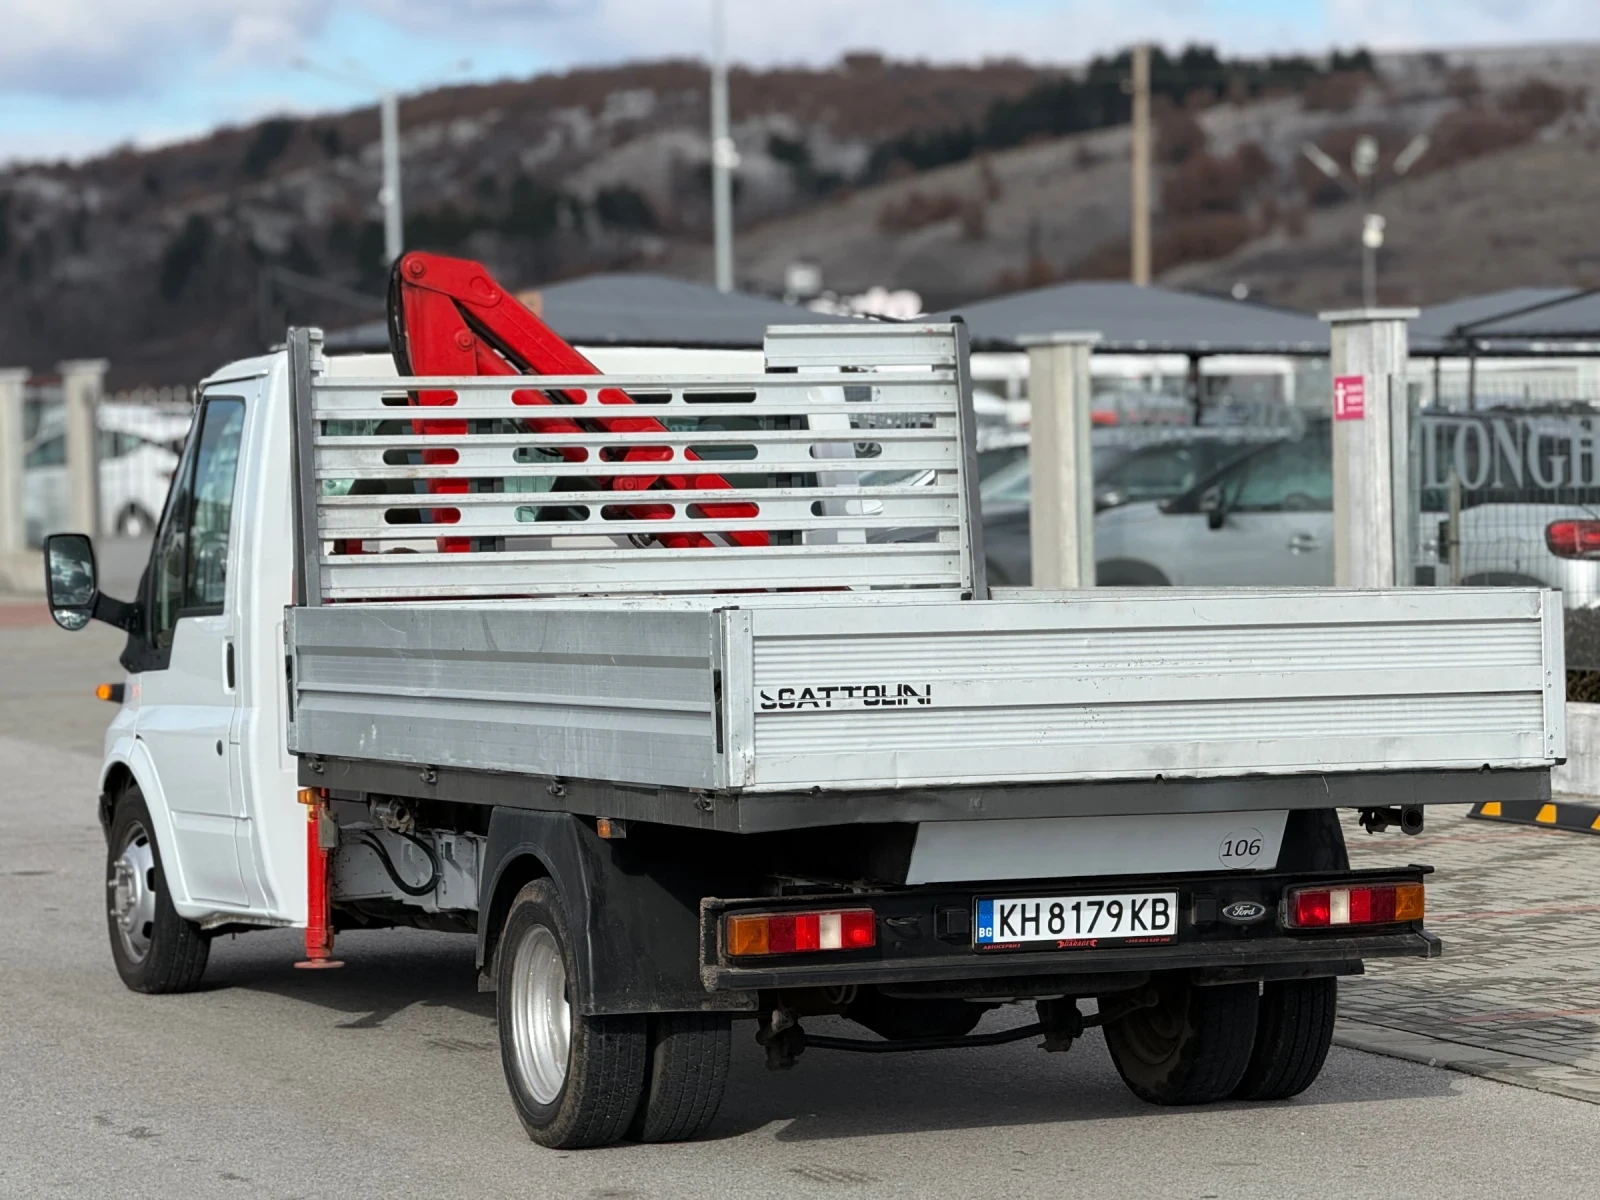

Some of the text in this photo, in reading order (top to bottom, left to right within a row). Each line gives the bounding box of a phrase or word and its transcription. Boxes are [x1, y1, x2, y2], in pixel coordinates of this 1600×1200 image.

[760, 683, 932, 710] SCATTOLINI
[1221, 838, 1262, 857] 106
[1232, 904, 1256, 917] Ford
[978, 926, 993, 939] BG
